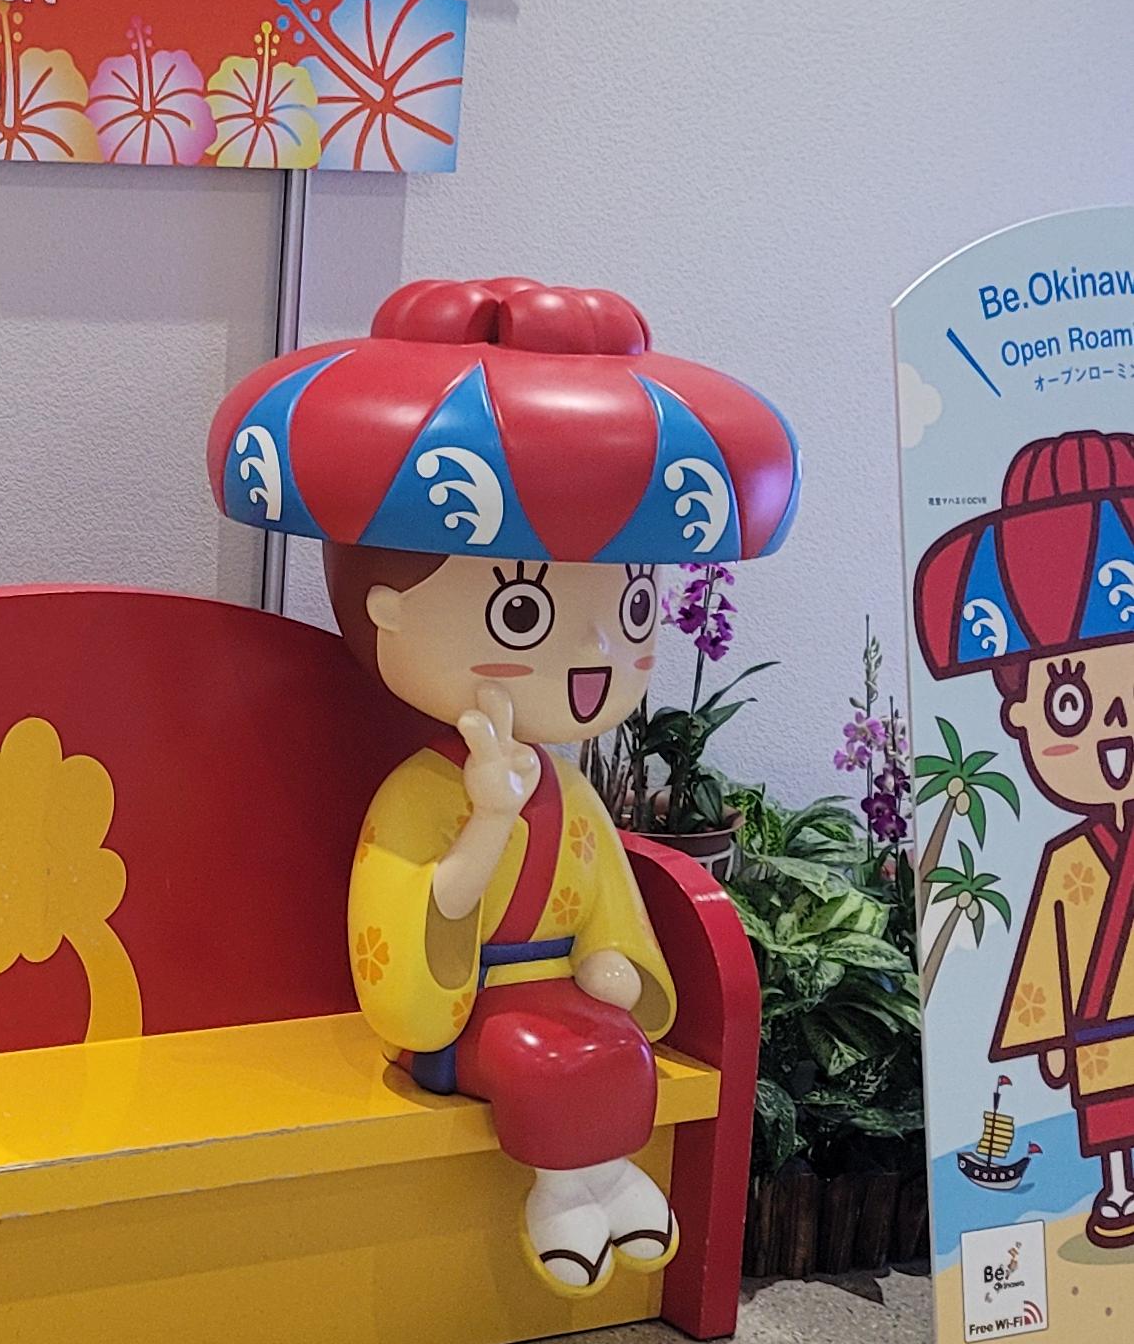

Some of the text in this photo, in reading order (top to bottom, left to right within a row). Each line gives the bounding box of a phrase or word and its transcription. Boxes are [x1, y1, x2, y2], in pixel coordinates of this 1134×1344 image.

[1001, 321, 1134, 367] Open Roam
[969, 1317, 1023, 1335] Free Wi-Fi
